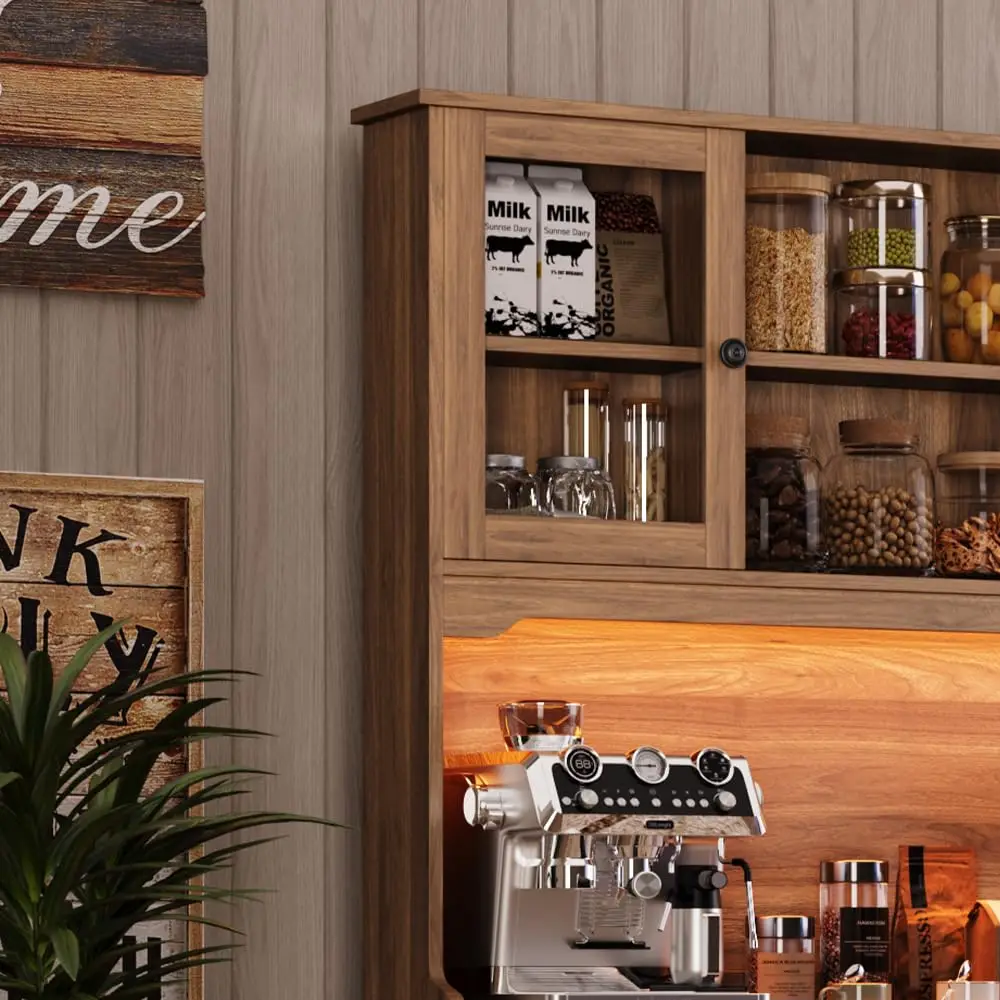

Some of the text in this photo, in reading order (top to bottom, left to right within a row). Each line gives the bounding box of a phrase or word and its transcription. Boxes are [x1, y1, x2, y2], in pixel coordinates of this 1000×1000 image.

[488, 200, 531, 220] Milk
[547, 204, 590, 224] Milk
[485, 222, 532, 234] Sunrise Dairy
[544, 227, 590, 238] Sunrise Dairy
[598, 243, 615, 337] ORGANIC
